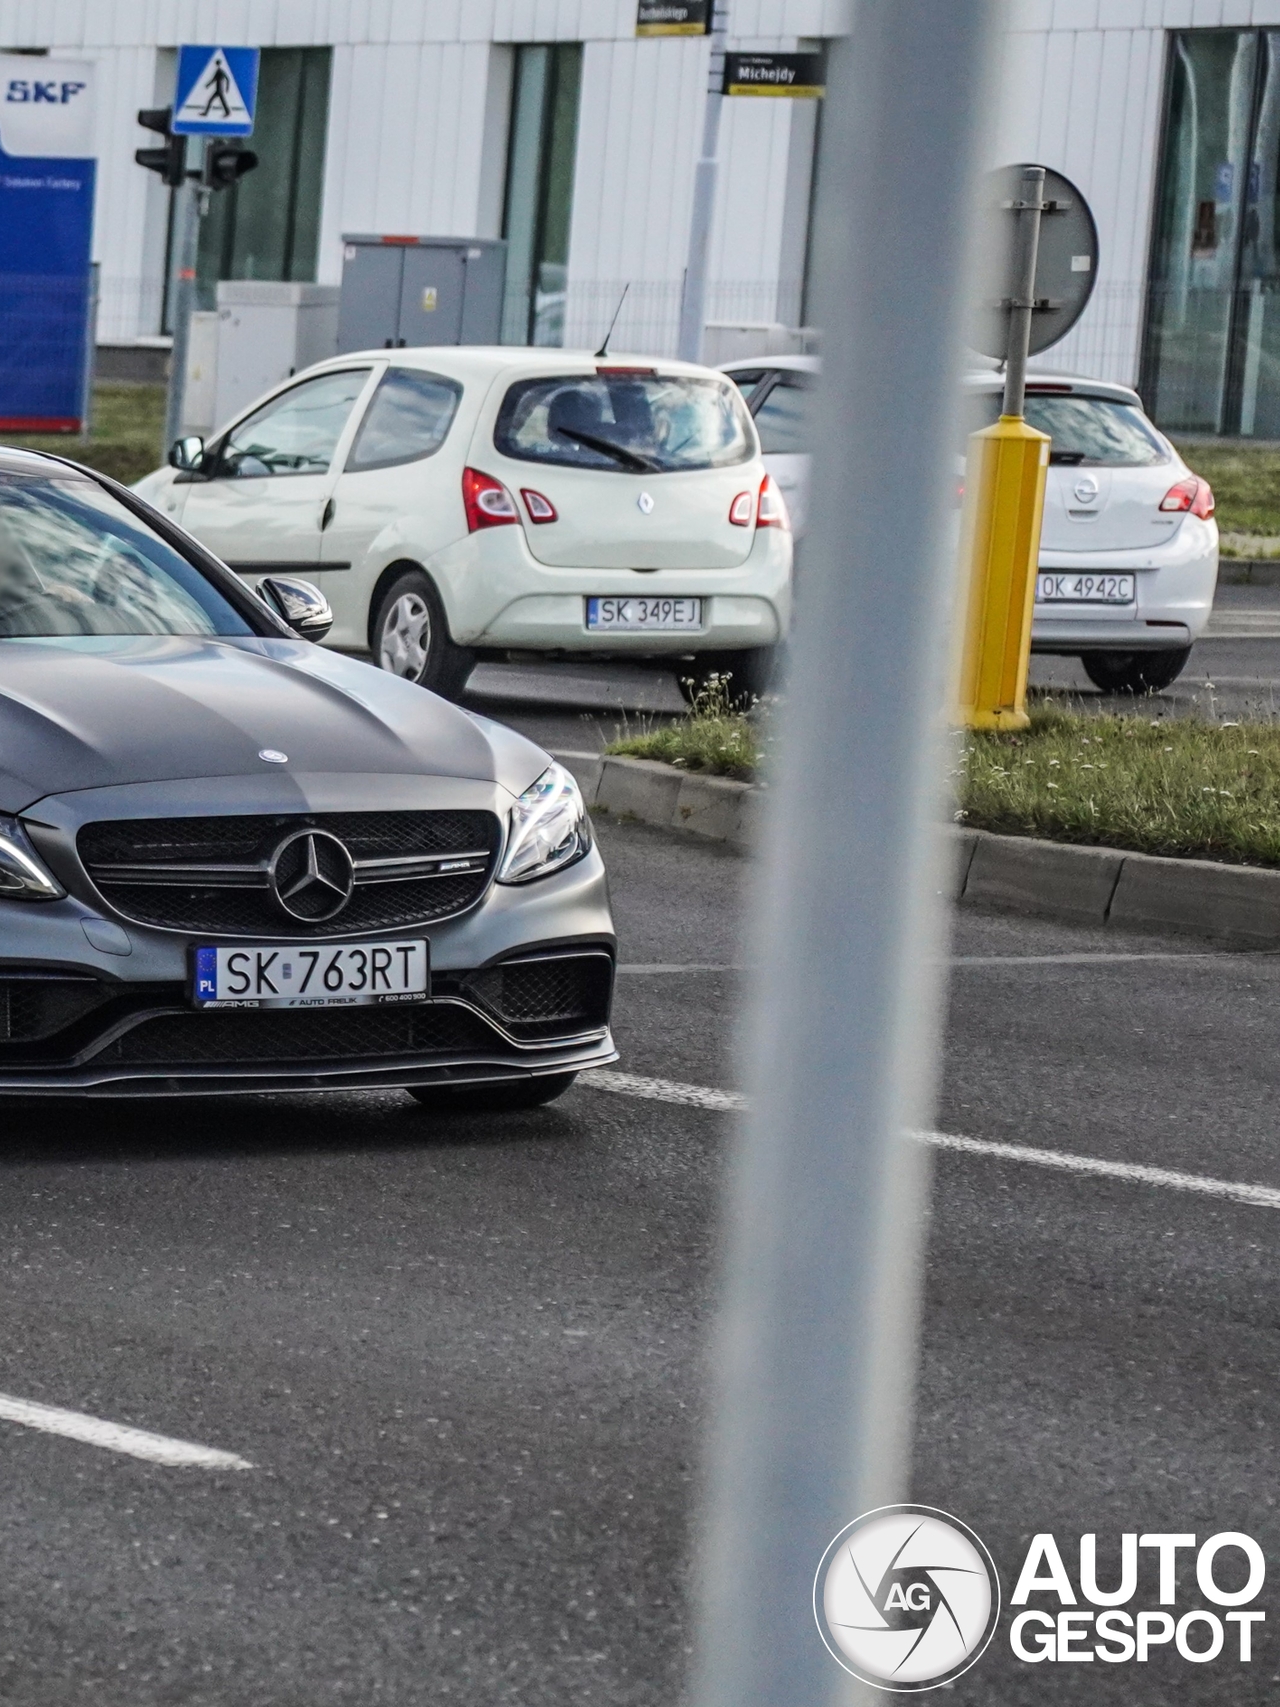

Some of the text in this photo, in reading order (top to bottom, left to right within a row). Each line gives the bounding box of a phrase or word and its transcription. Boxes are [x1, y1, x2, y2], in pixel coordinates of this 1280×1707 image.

[738, 66, 796, 83] Michejdy
[6, 80, 86, 104] SKF
[1043, 577, 1129, 598] OK 4942C
[602, 601, 695, 622] SK 349EJ
[227, 946, 417, 994] SK 763RT
[200, 980, 214, 992] PL
[300, 998, 325, 1006] AUTO
